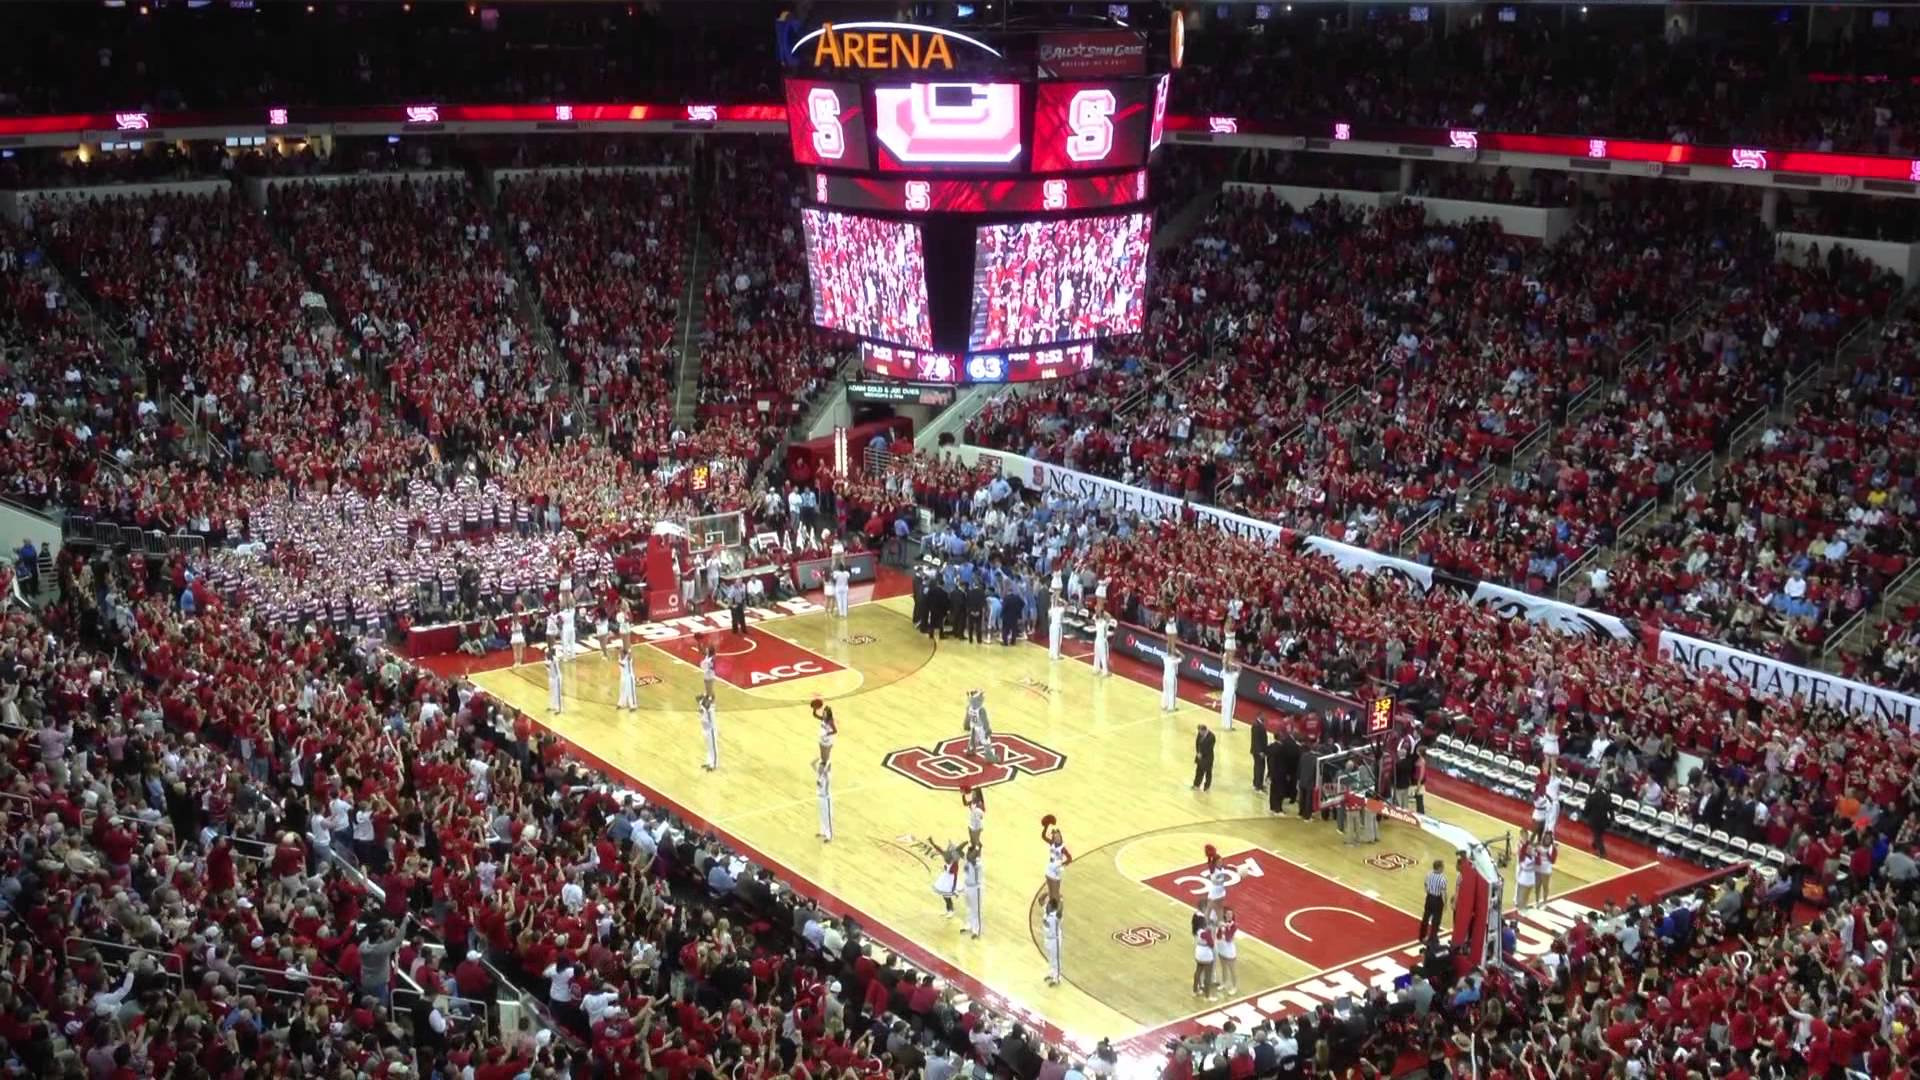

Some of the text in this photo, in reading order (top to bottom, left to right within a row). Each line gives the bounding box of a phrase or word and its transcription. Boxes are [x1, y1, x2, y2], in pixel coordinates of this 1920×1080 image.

[814, 23, 953, 69] ARENA
[970, 356, 1001, 379] 63
[693, 476, 707, 490] 35
[1049, 468, 1074, 492] NC
[1076, 476, 1134, 510] STATE
[1141, 494, 1273, 544] UNIERSITY
[751, 661, 822, 685] ACC
[1673, 640, 1716, 673] NC
[1728, 655, 1831, 706] STATE
[1372, 710, 1387, 730] 35
